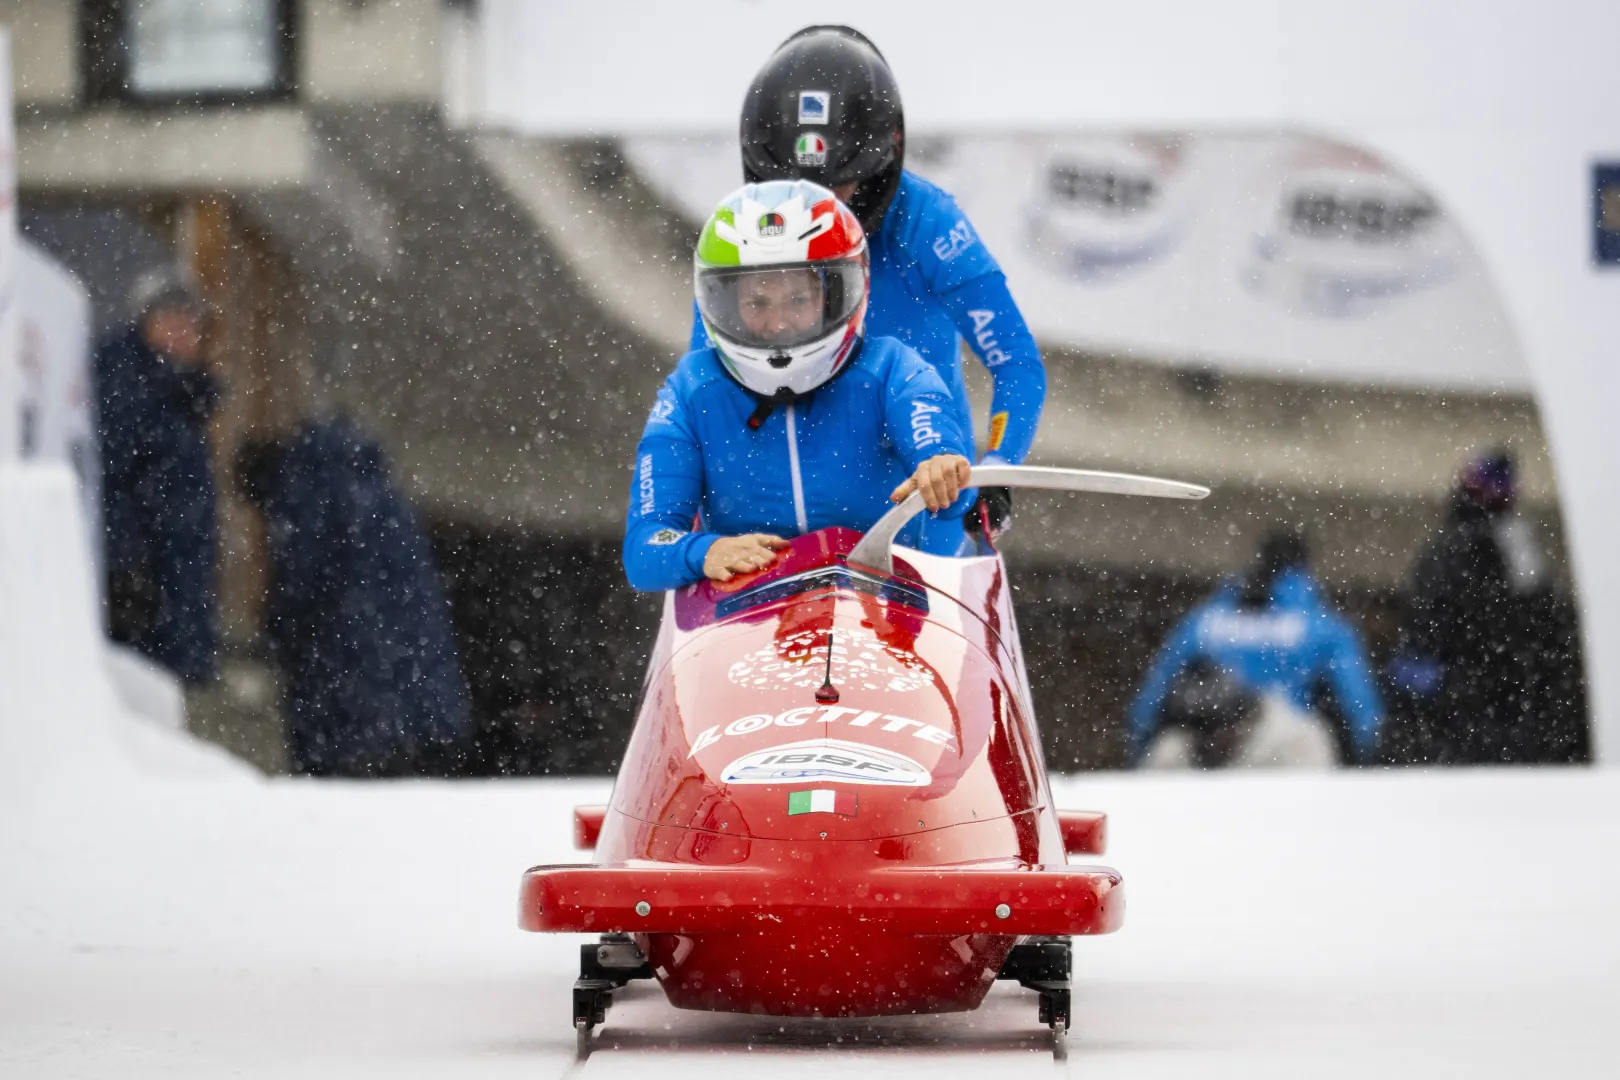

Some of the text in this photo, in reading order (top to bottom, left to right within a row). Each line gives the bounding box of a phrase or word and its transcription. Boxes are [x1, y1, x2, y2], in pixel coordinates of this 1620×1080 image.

[760, 225, 783, 236] agv
[966, 308, 1013, 367] Aud
[910, 400, 942, 450] Audi
[760, 655, 904, 677] CHAGALL
[686, 705, 955, 759] LOCTITE
[760, 753, 895, 773] IBSF
